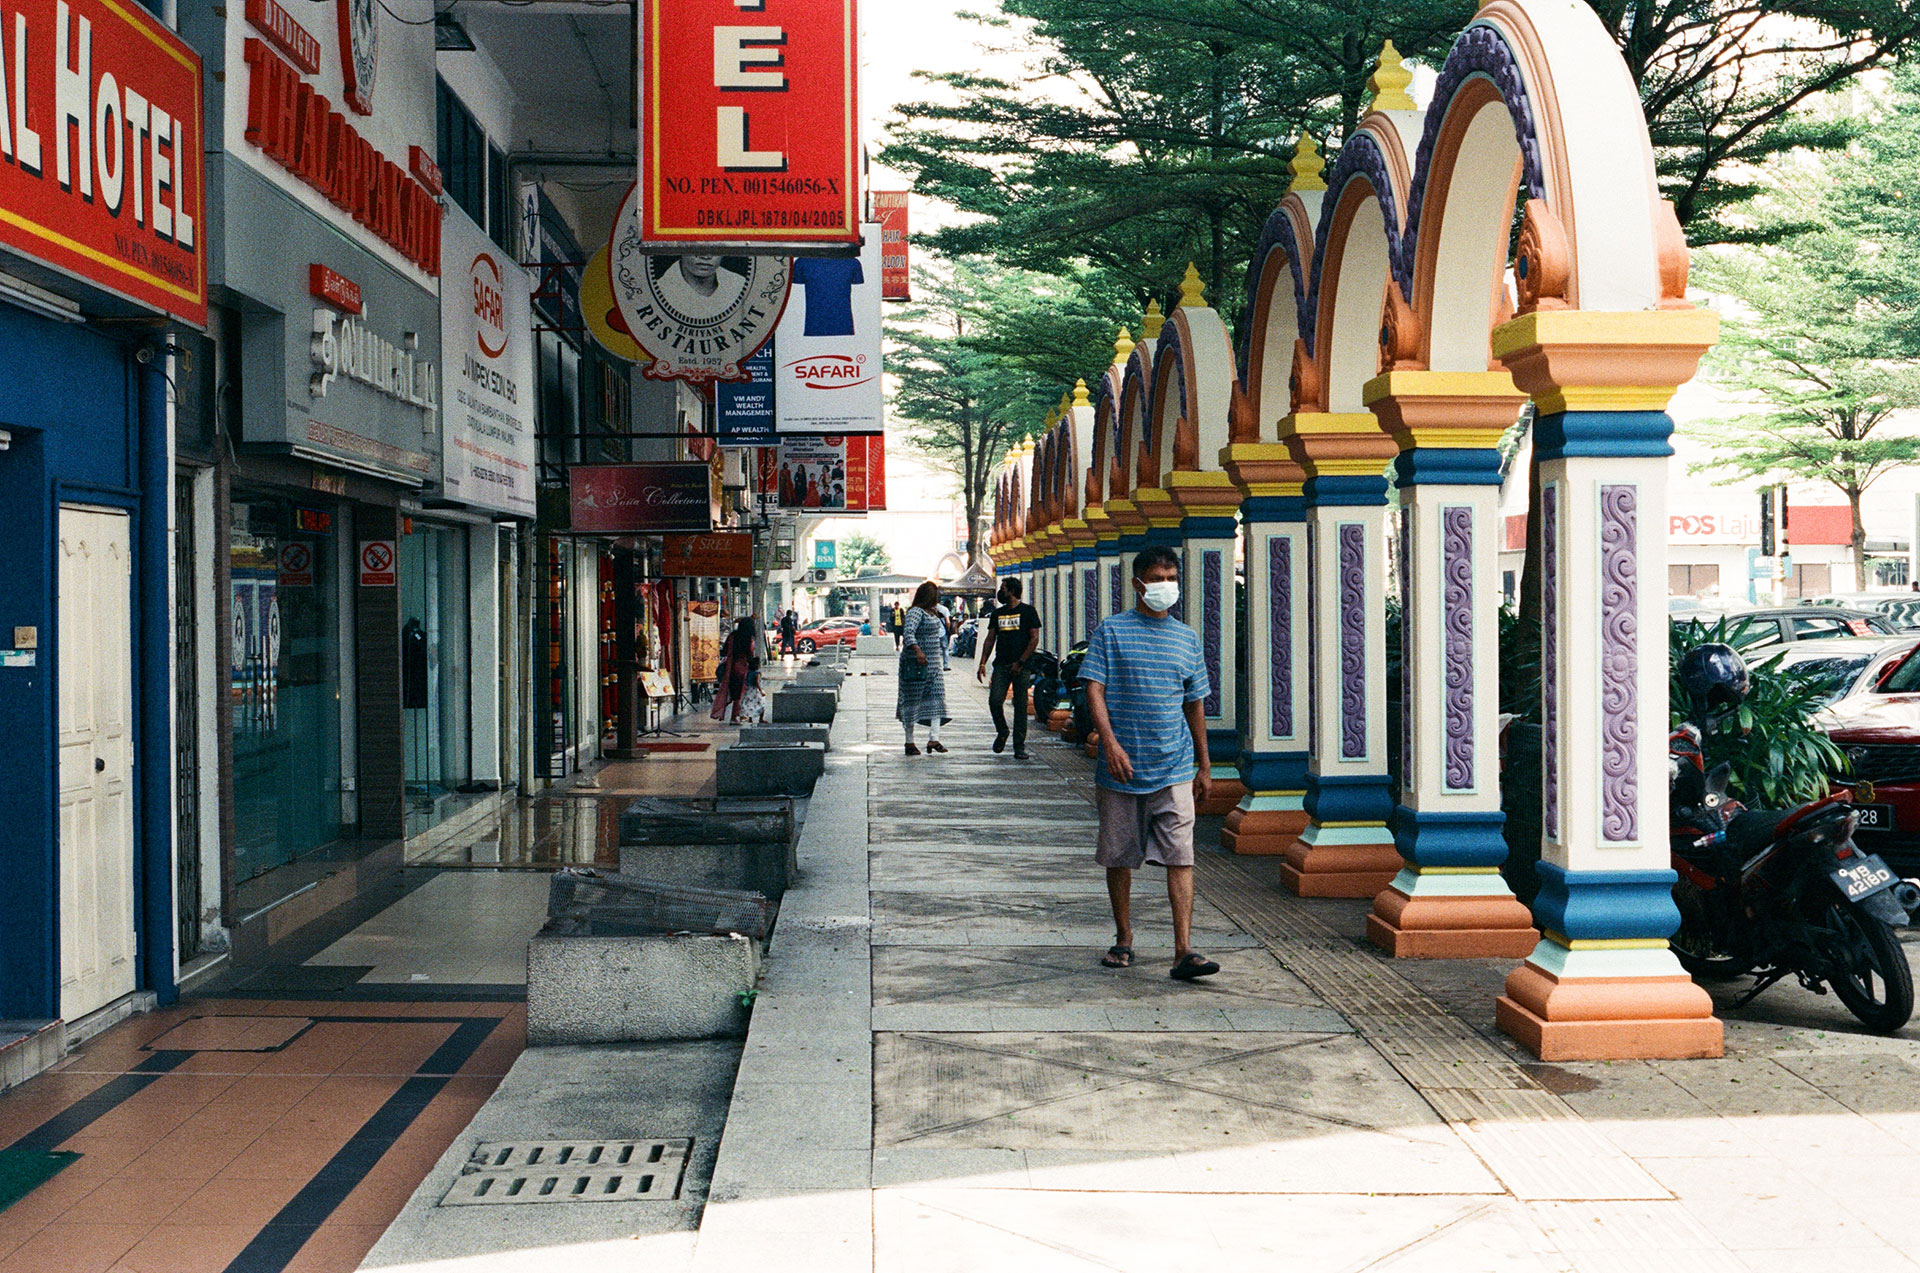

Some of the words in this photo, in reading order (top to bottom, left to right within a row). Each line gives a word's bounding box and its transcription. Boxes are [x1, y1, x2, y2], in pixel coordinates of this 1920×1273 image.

[265, 0, 317, 70] DINDIGUL
[713, 0, 785, 168] EL
[0, 6, 42, 172] L
[56, 0, 194, 248] HOTEL
[666, 177, 695, 195] NO.
[701, 177, 738, 195] PEN.
[743, 177, 839, 195] 001546056-X
[881, 255, 906, 268] ALOON
[474, 276, 504, 332] SAFARI
[636, 304, 766, 355] RESTAURANT
[677, 325, 724, 338] BIRIYANI
[795, 365, 860, 379] SAFARI
[1669, 514, 1716, 536] POS
[1720, 514, 1761, 540] Laju
[817, 555, 834, 563] BSN
[1861, 809, 1878, 825] 28
[1848, 869, 1890, 896] 4218D
